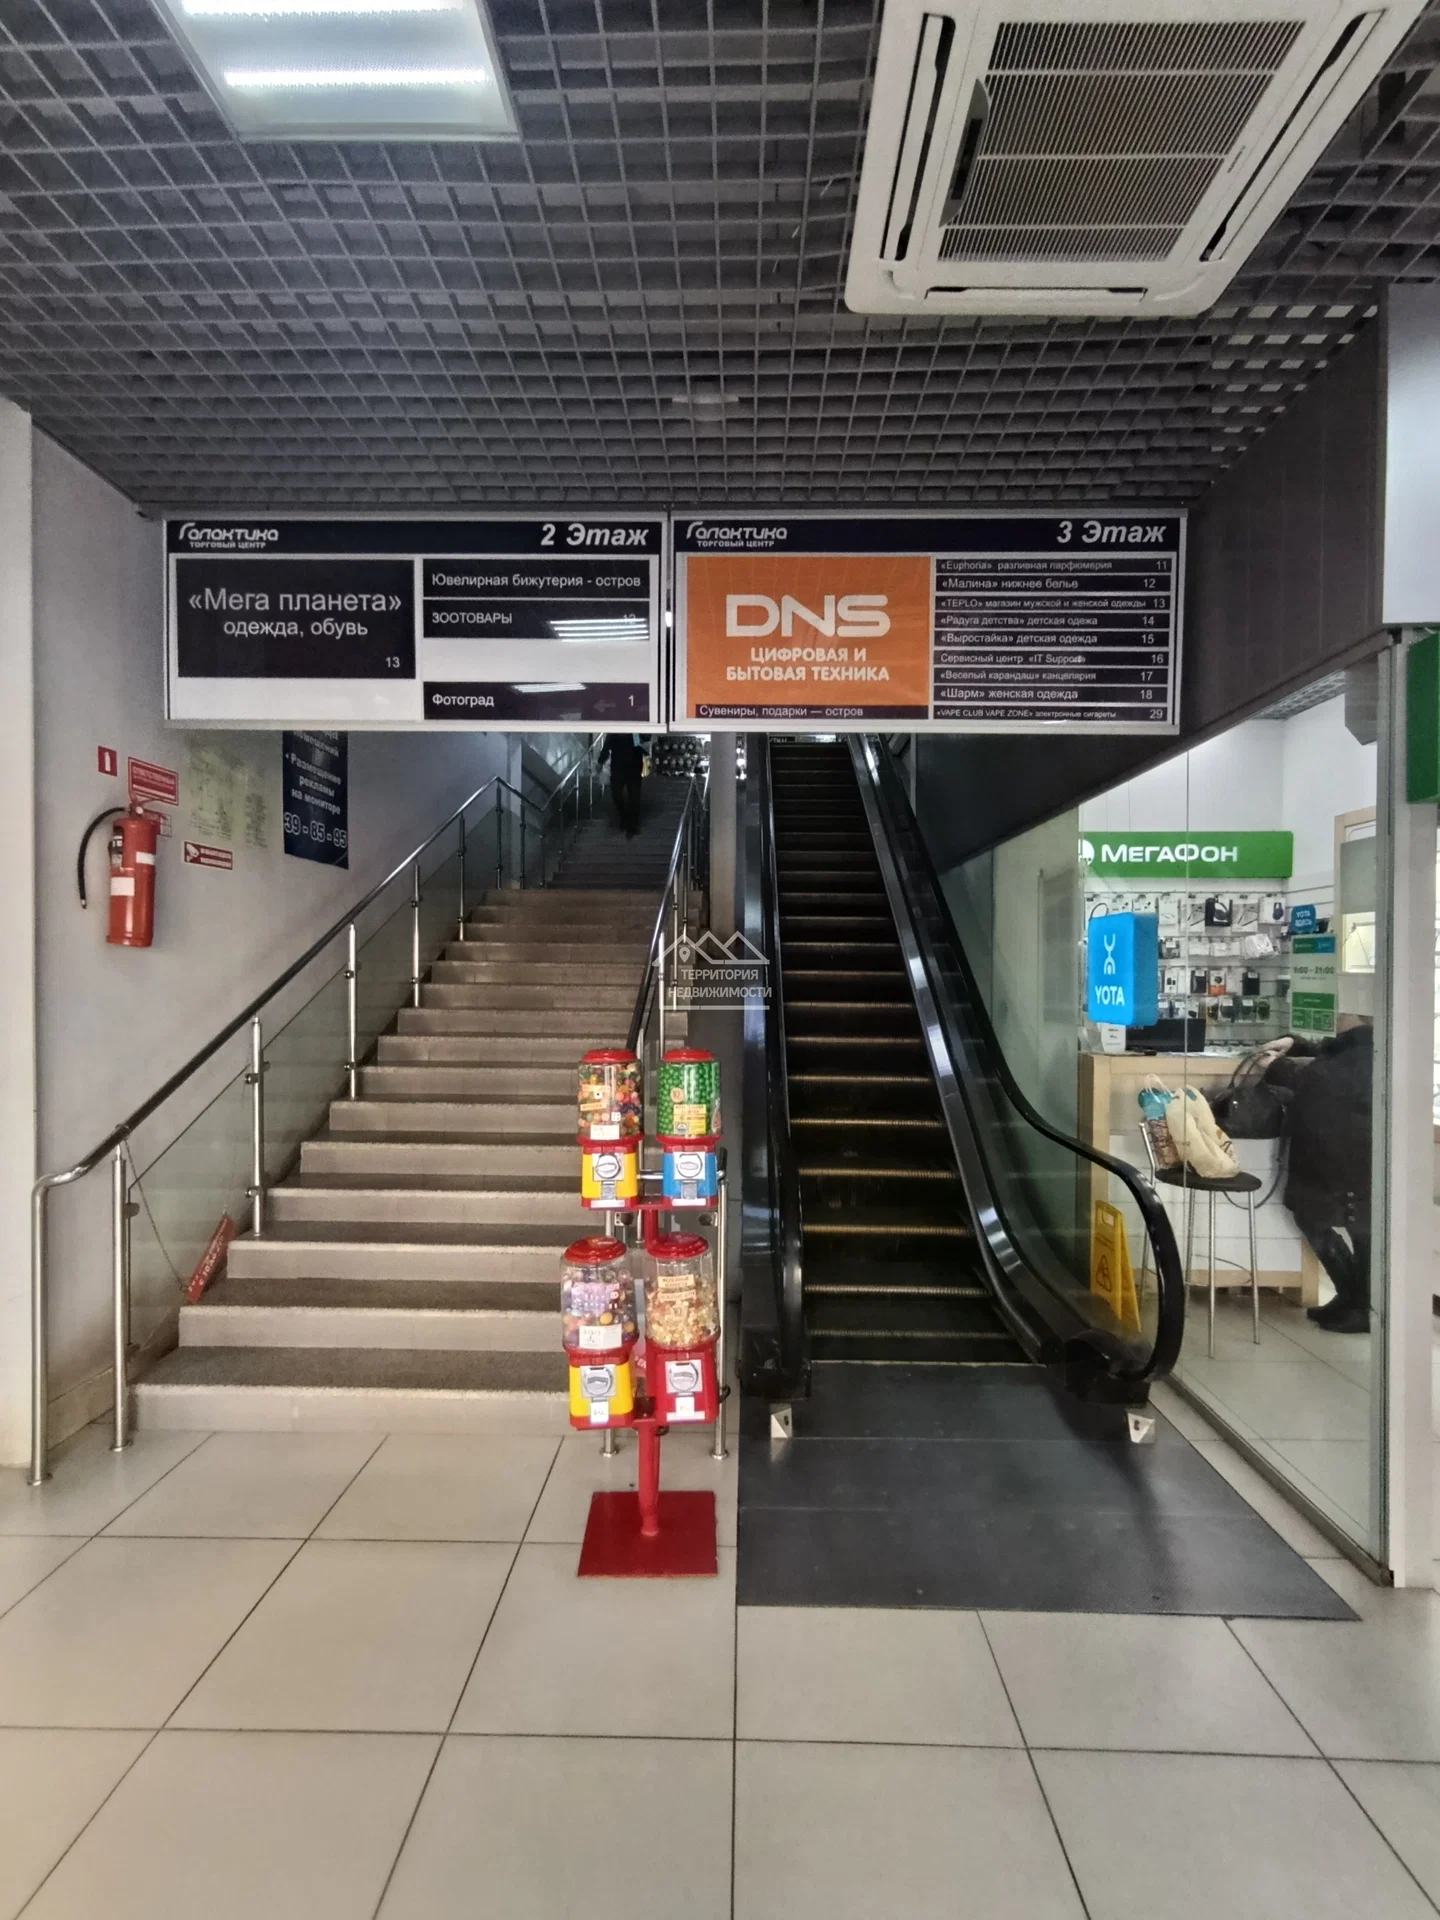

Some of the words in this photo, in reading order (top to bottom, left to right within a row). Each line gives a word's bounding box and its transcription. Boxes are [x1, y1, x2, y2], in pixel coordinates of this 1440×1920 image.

[541, 523, 556, 546] 2
[566, 523, 649, 546] Этаж
[1056, 520, 1073, 544] 3
[1082, 520, 1167, 544] Этаж
[941, 560, 993, 571] «Euphoria»
[998, 562, 1047, 571] разливная
[1049, 561, 1112, 571] парфюмерия
[1156, 560, 1167, 570] 11
[432, 574, 508, 588] Ювелирная
[512, 573, 583, 588] бижутерия
[595, 576, 641, 588] остров
[942, 578, 998, 589] «Малина»
[1001, 580, 1043, 588] нижнее
[1045, 578, 1078, 588] белье
[1143, 578, 1156, 588] 12
[189, 587, 269, 611] «Мега
[279, 592, 402, 612] планета»
[941, 599, 983, 608] «TEPLO»
[985, 600, 1022, 608] магазин
[1024, 599, 1061, 609] мужской
[1072, 599, 1107, 608] женской
[1111, 600, 1146, 609] одежды
[1153, 598, 1166, 608] 13
[432, 612, 513, 624] ЗООТОВАРЫ
[726, 594, 891, 637] DNS
[940, 616, 979, 626] «Радуга
[981, 617, 1025, 626] детства»
[1027, 617, 1065, 626] детская
[1142, 616, 1155, 625] 14
[223, 620, 304, 638] одежда,
[310, 618, 368, 639] обувь
[941, 633, 1014, 644] «Выростайка»
[1016, 635, 1056, 644] детская
[1059, 634, 1098, 644] одежда
[1141, 634, 1155, 644] 15
[751, 647, 848, 663] ЦИФРОВАЯ
[854, 647, 867, 662] И
[940, 653, 994, 664] Сервисный
[996, 656, 1023, 664] центр
[1151, 653, 1164, 663] 16
[385, 657, 401, 668] 13
[726, 666, 806, 681] БЫТОВАЯ
[812, 666, 890, 681] ТЕХНИКА
[940, 670, 987, 680] «Веселый
[989, 672, 1040, 681] карандаш»
[1042, 672, 1097, 681] канцелярия
[1140, 671, 1153, 681] 17
[432, 693, 495, 708] Фотоград
[628, 695, 634, 707] 1
[940, 689, 985, 699] «Шарм»
[988, 689, 1034, 699] женская
[1037, 690, 1079, 700] одежда
[1140, 689, 1153, 700] 18
[699, 705, 758, 717] Сувениры,
[762, 707, 807, 718] подарки
[825, 707, 864, 718] остров
[963, 709, 984, 717] CLUB
[986, 709, 1005, 717] VAPE
[1150, 708, 1163, 719] 29
[299, 776, 335, 797] рекламы
[291, 789, 303, 800] на
[305, 794, 341, 815] мониторе
[1095, 985, 1125, 1006] YOTA
